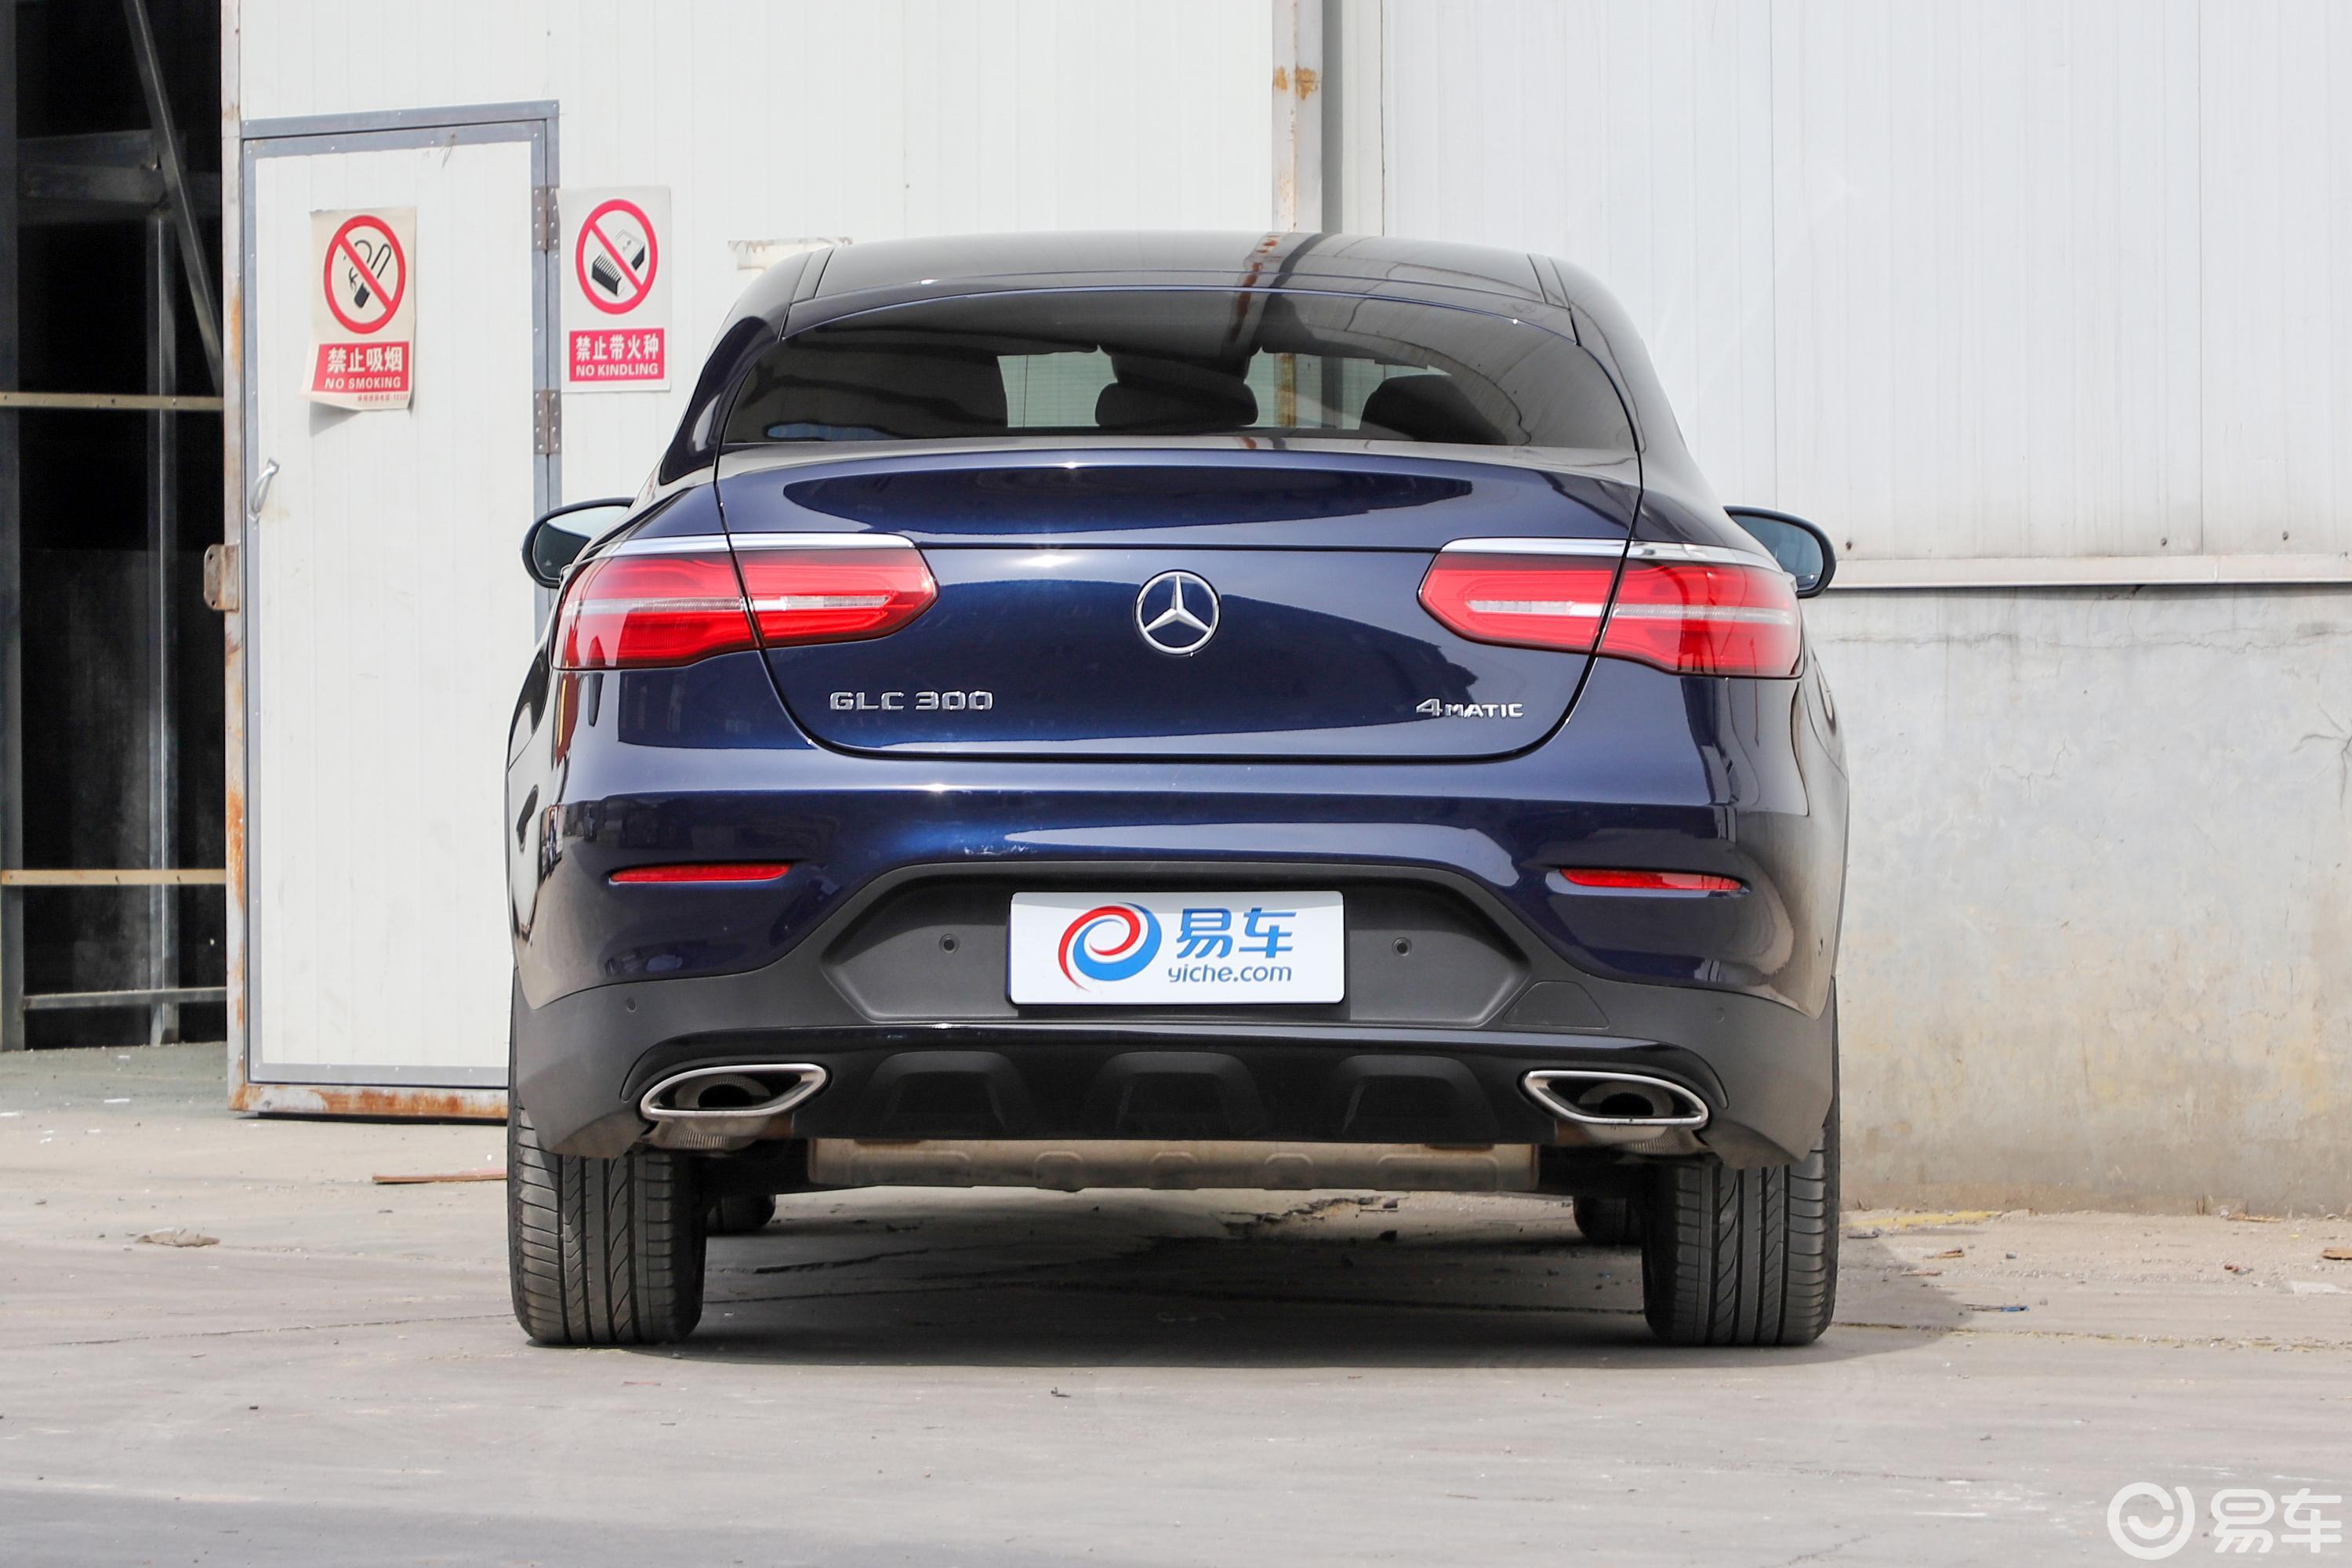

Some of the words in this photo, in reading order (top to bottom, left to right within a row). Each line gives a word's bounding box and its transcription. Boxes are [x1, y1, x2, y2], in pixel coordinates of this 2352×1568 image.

[575, 332, 659, 361] 禁止带火种
[327, 346, 403, 373] 禁止吸烟
[575, 364, 595, 377] NO
[597, 362, 659, 376] KINDLING
[324, 377, 345, 389] NO
[348, 376, 401, 389] SMOKING
[829, 691, 905, 710] GLC
[915, 691, 993, 710] 300
[1416, 699, 1524, 718] 4MATIC
[1176, 907, 1297, 959] 易车
[1168, 964, 1292, 983] yiche.com
